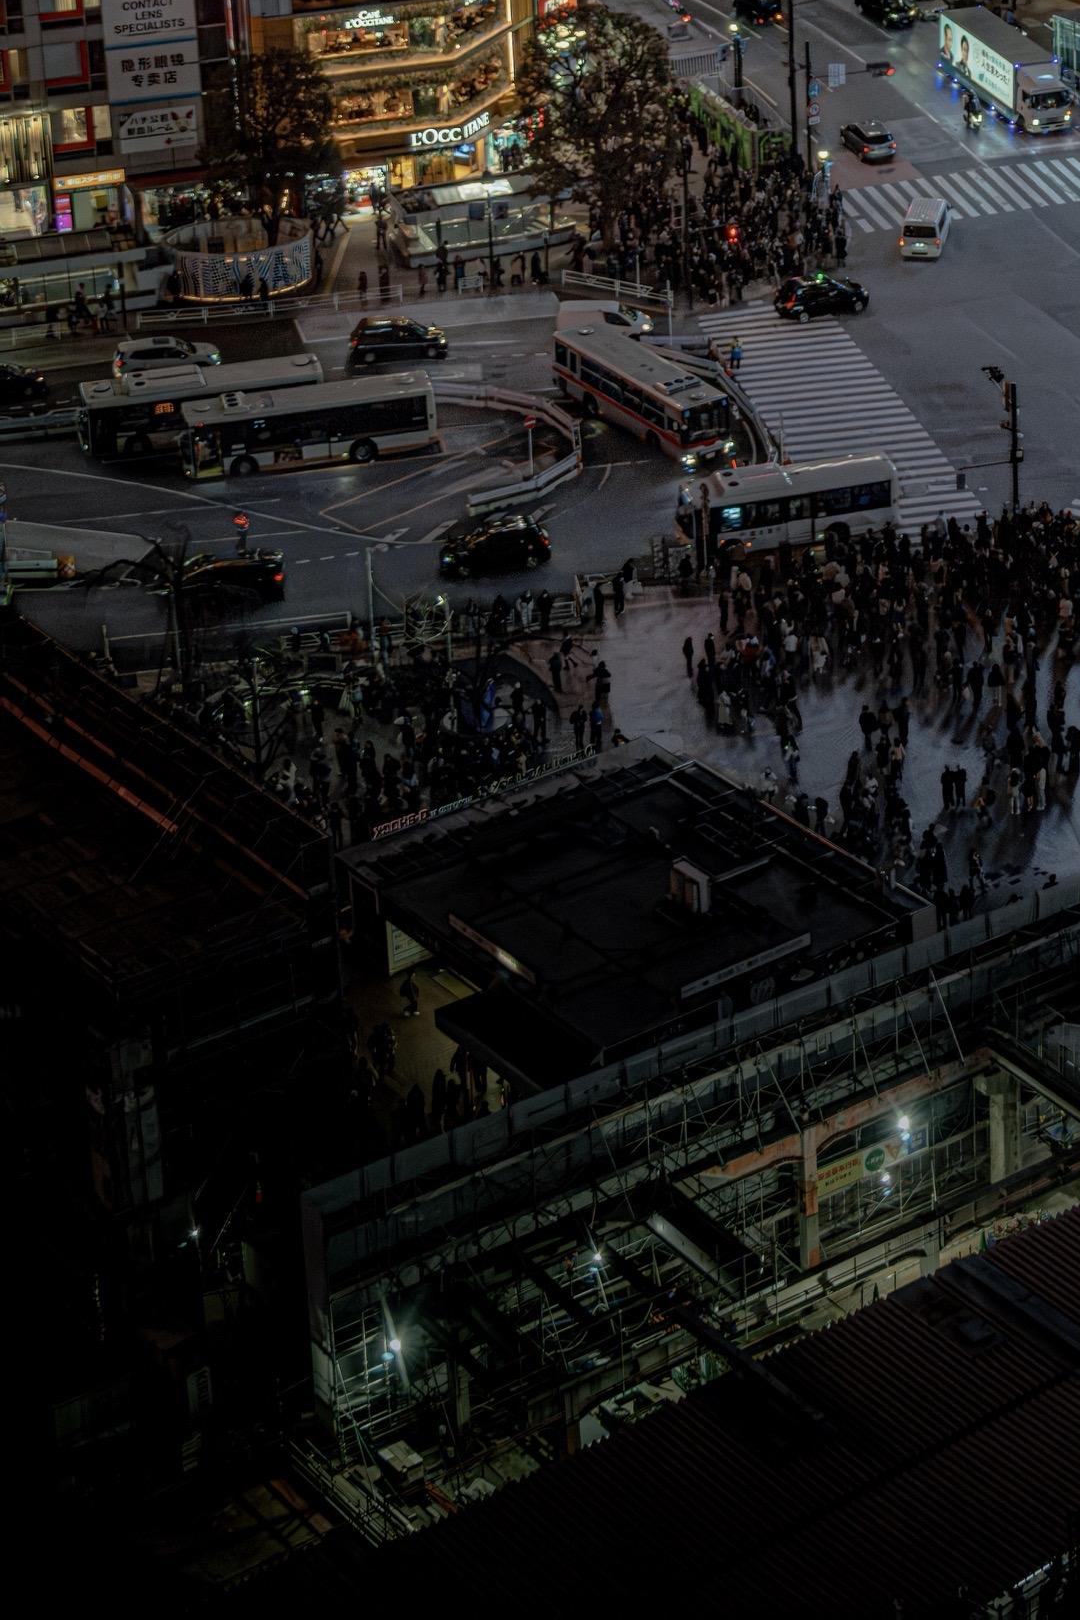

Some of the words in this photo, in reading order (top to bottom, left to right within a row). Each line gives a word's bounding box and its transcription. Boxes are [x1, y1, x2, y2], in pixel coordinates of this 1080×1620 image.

[135, 9, 163, 21] LENS
[114, 18, 186, 35] SPECIALISTS
[411, 112, 489, 146] L'OCCITANE
